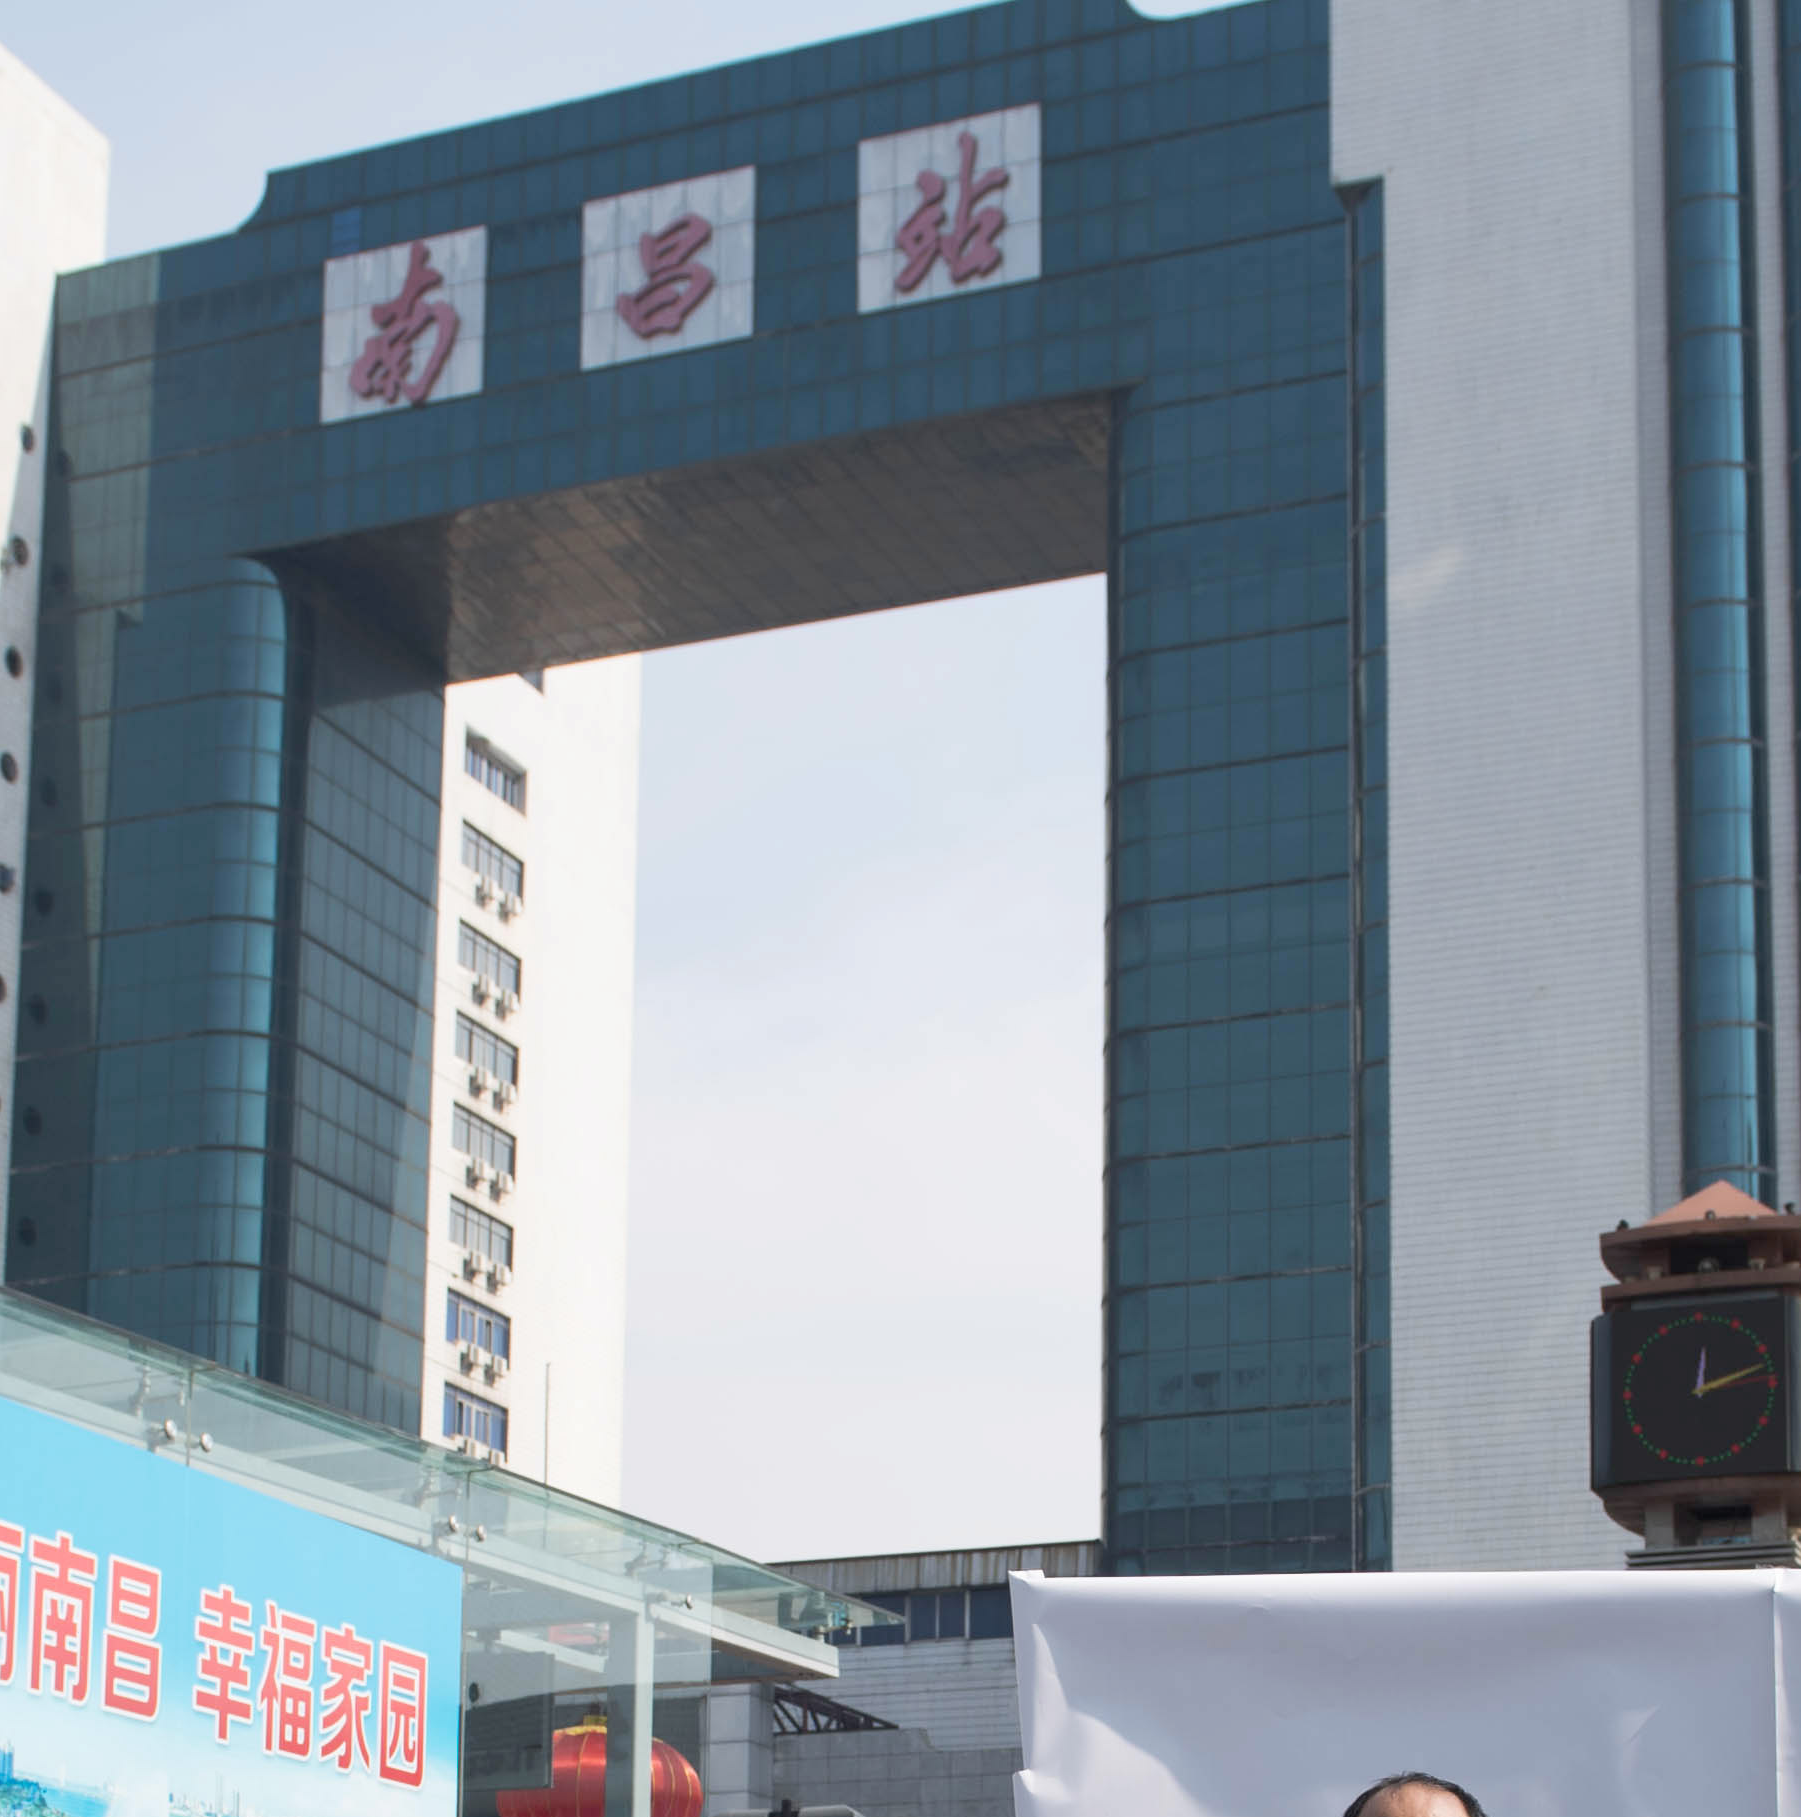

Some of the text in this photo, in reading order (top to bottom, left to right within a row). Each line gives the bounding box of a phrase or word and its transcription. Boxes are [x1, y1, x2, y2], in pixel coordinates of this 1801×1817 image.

[350, 132, 1009, 406] 南昌站
[194, 1586, 428, 1789] 幸福家园
